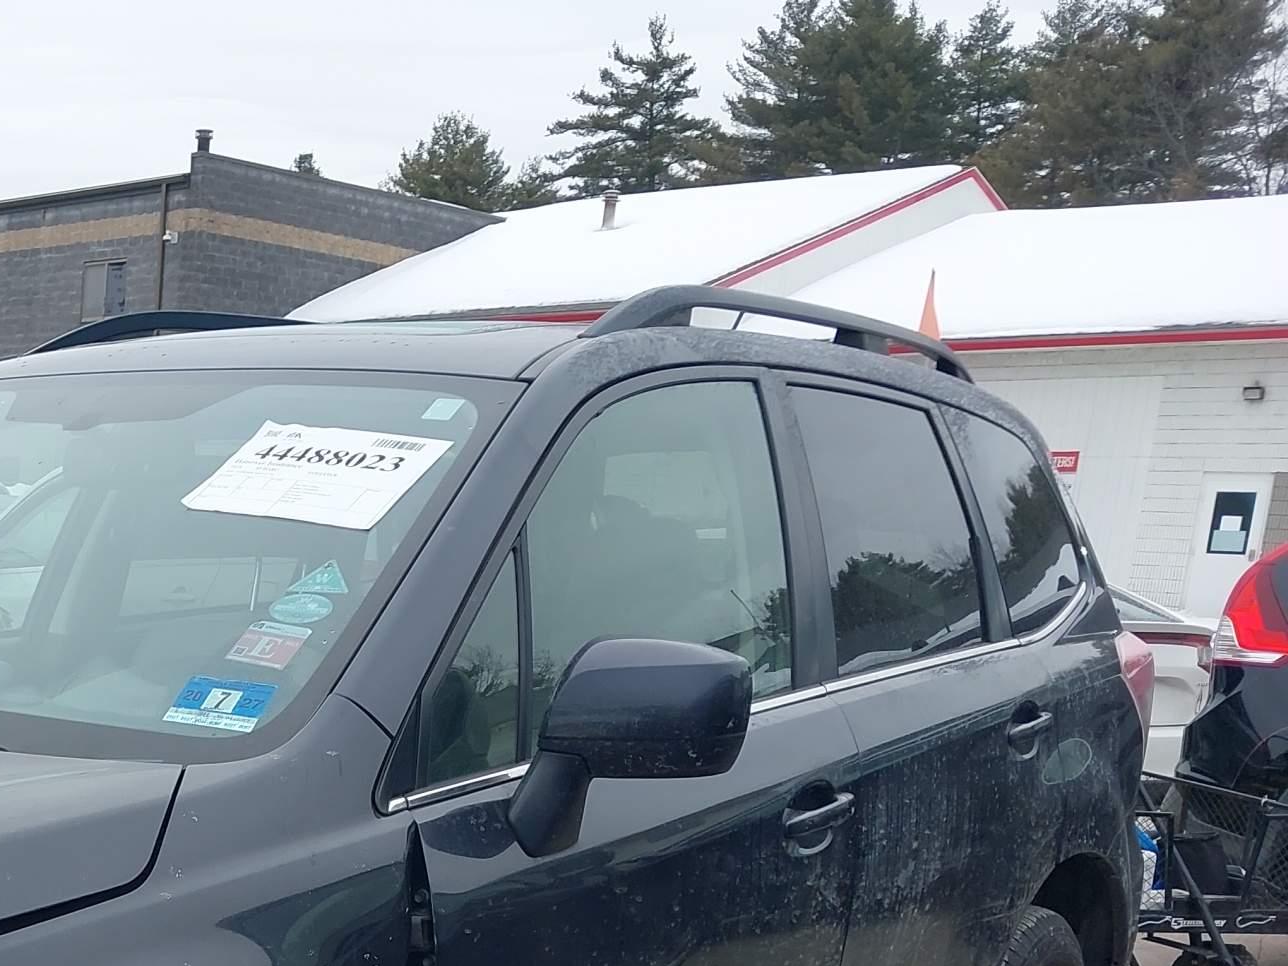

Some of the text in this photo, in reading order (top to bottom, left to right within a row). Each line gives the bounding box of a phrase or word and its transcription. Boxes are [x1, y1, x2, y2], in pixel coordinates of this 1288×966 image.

[254, 444, 406, 472] 44488023
[214, 692, 232, 710] 7
[239, 698, 264, 710] 27
